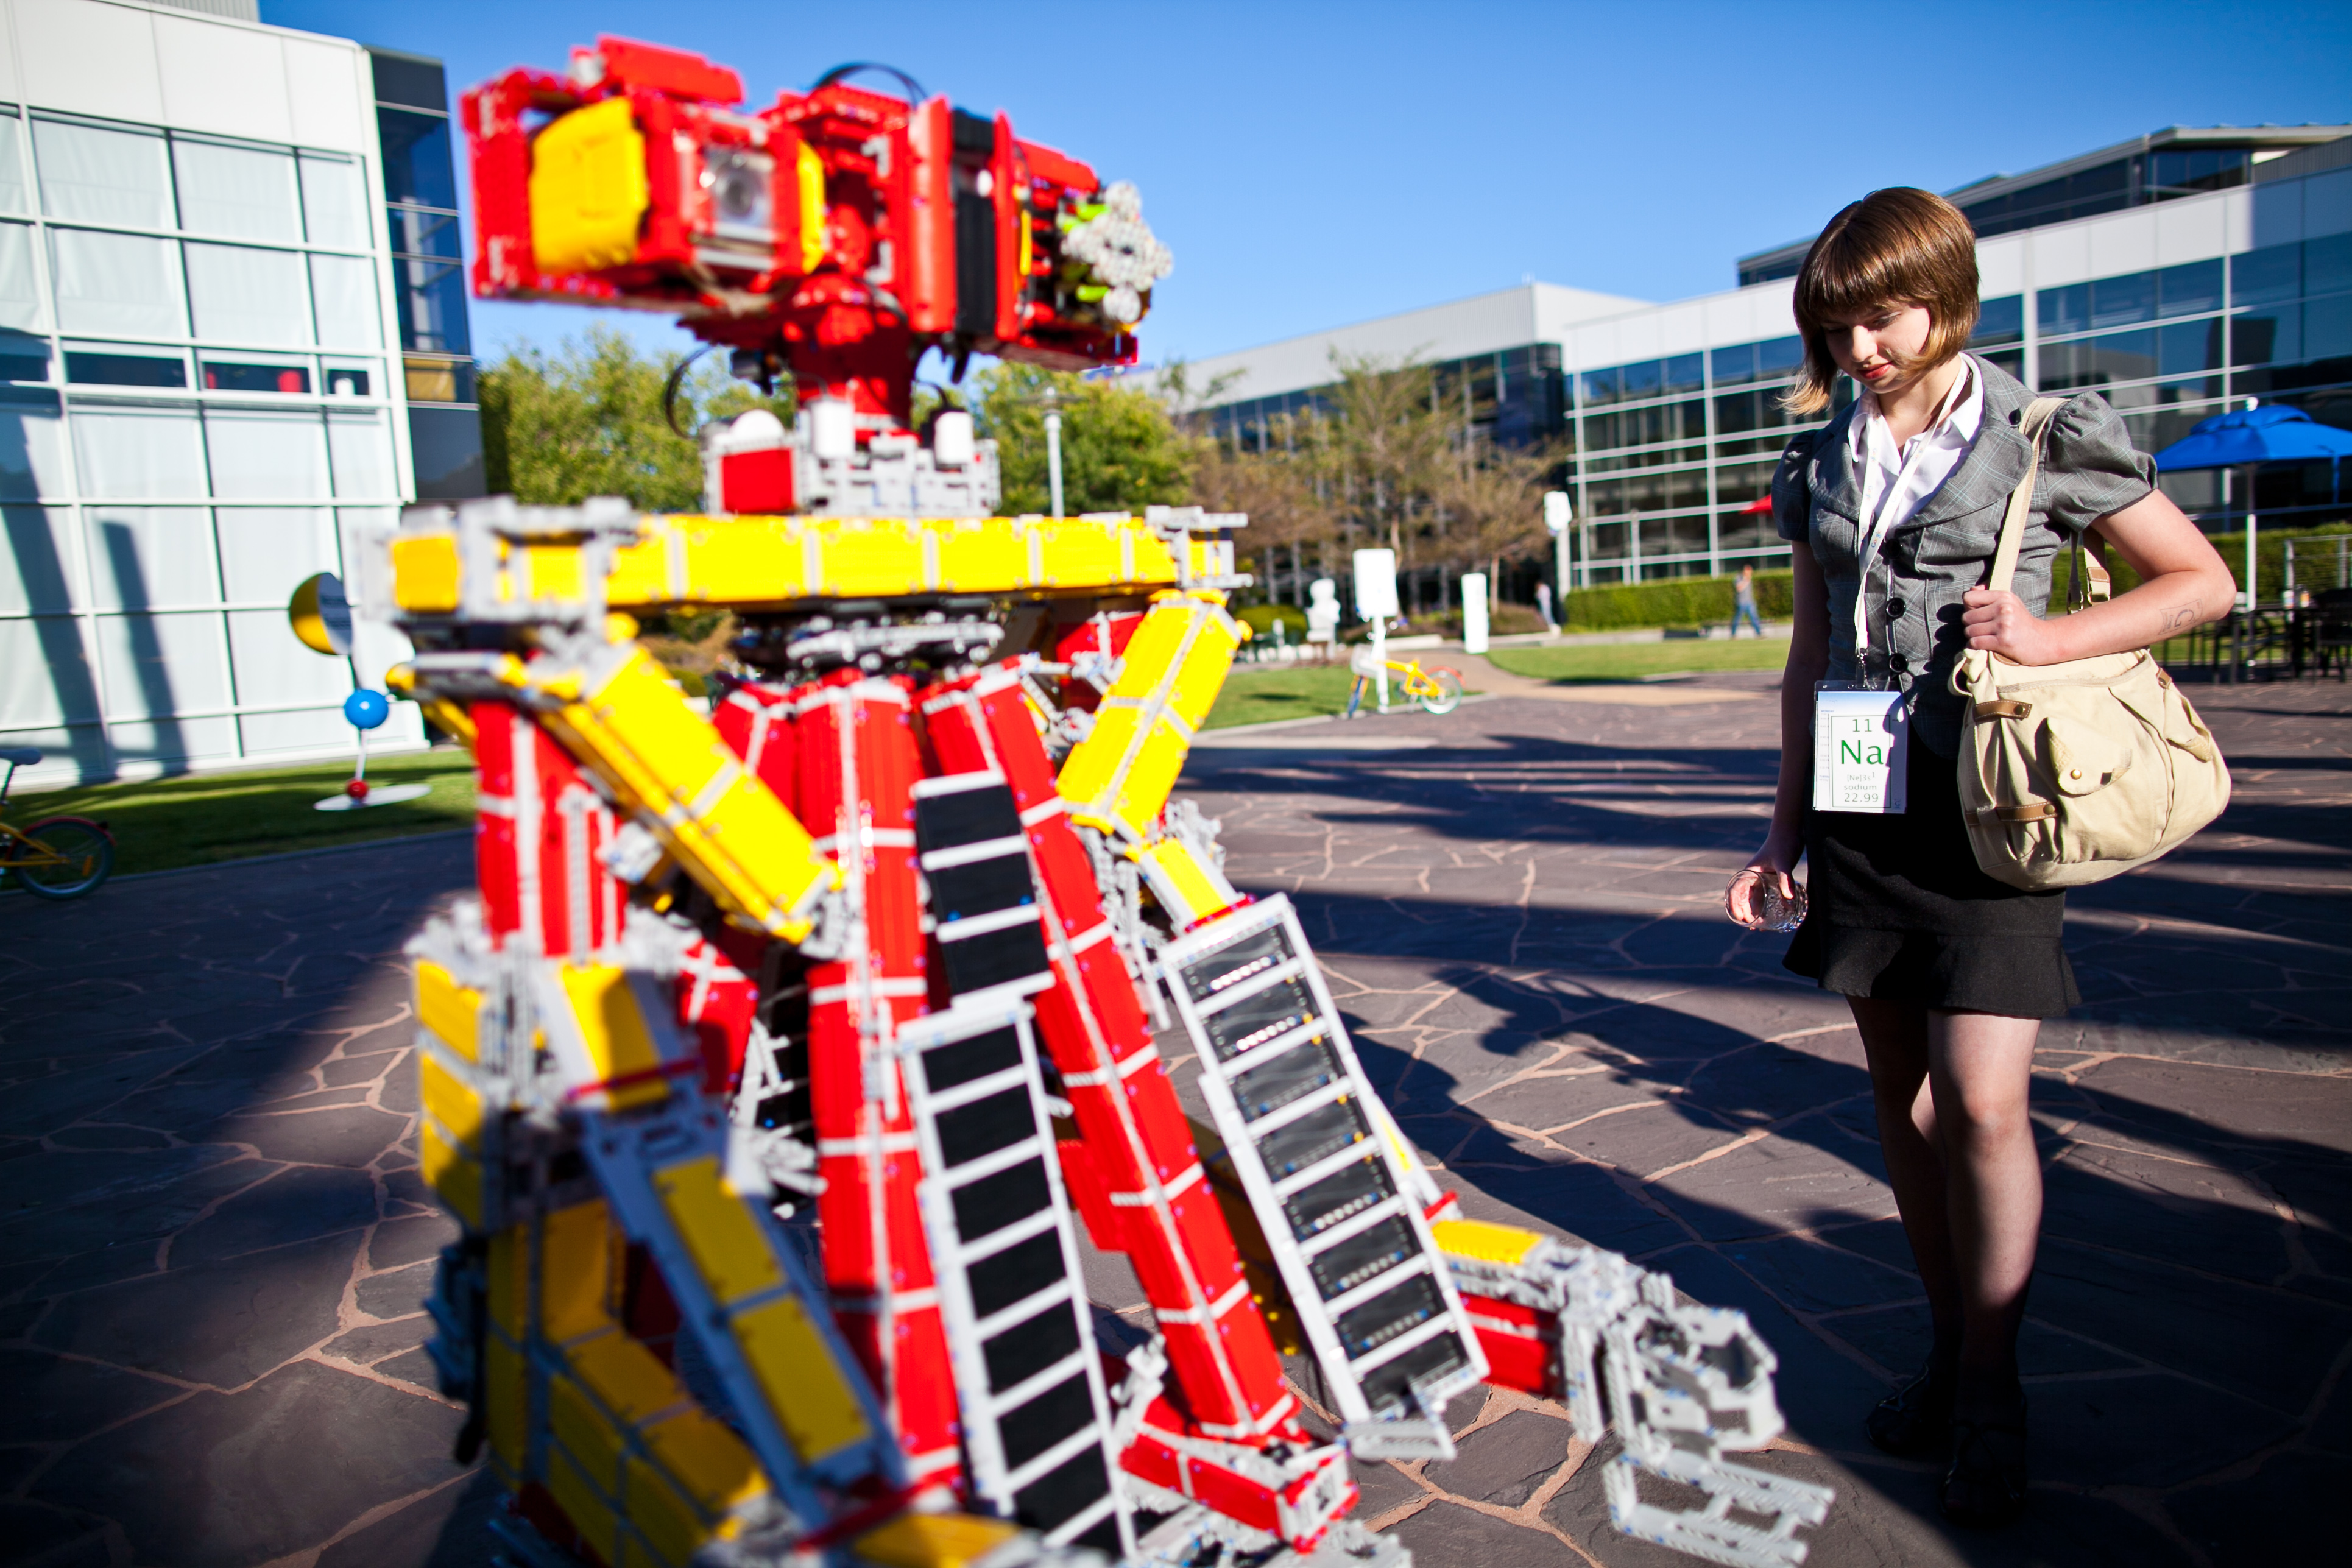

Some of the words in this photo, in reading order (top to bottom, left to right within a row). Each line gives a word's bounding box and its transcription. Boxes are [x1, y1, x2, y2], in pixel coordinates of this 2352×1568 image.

[1852, 719, 1872, 732] 11
[1841, 740, 1884, 765] Na
[1844, 793, 1879, 802] 22.99
